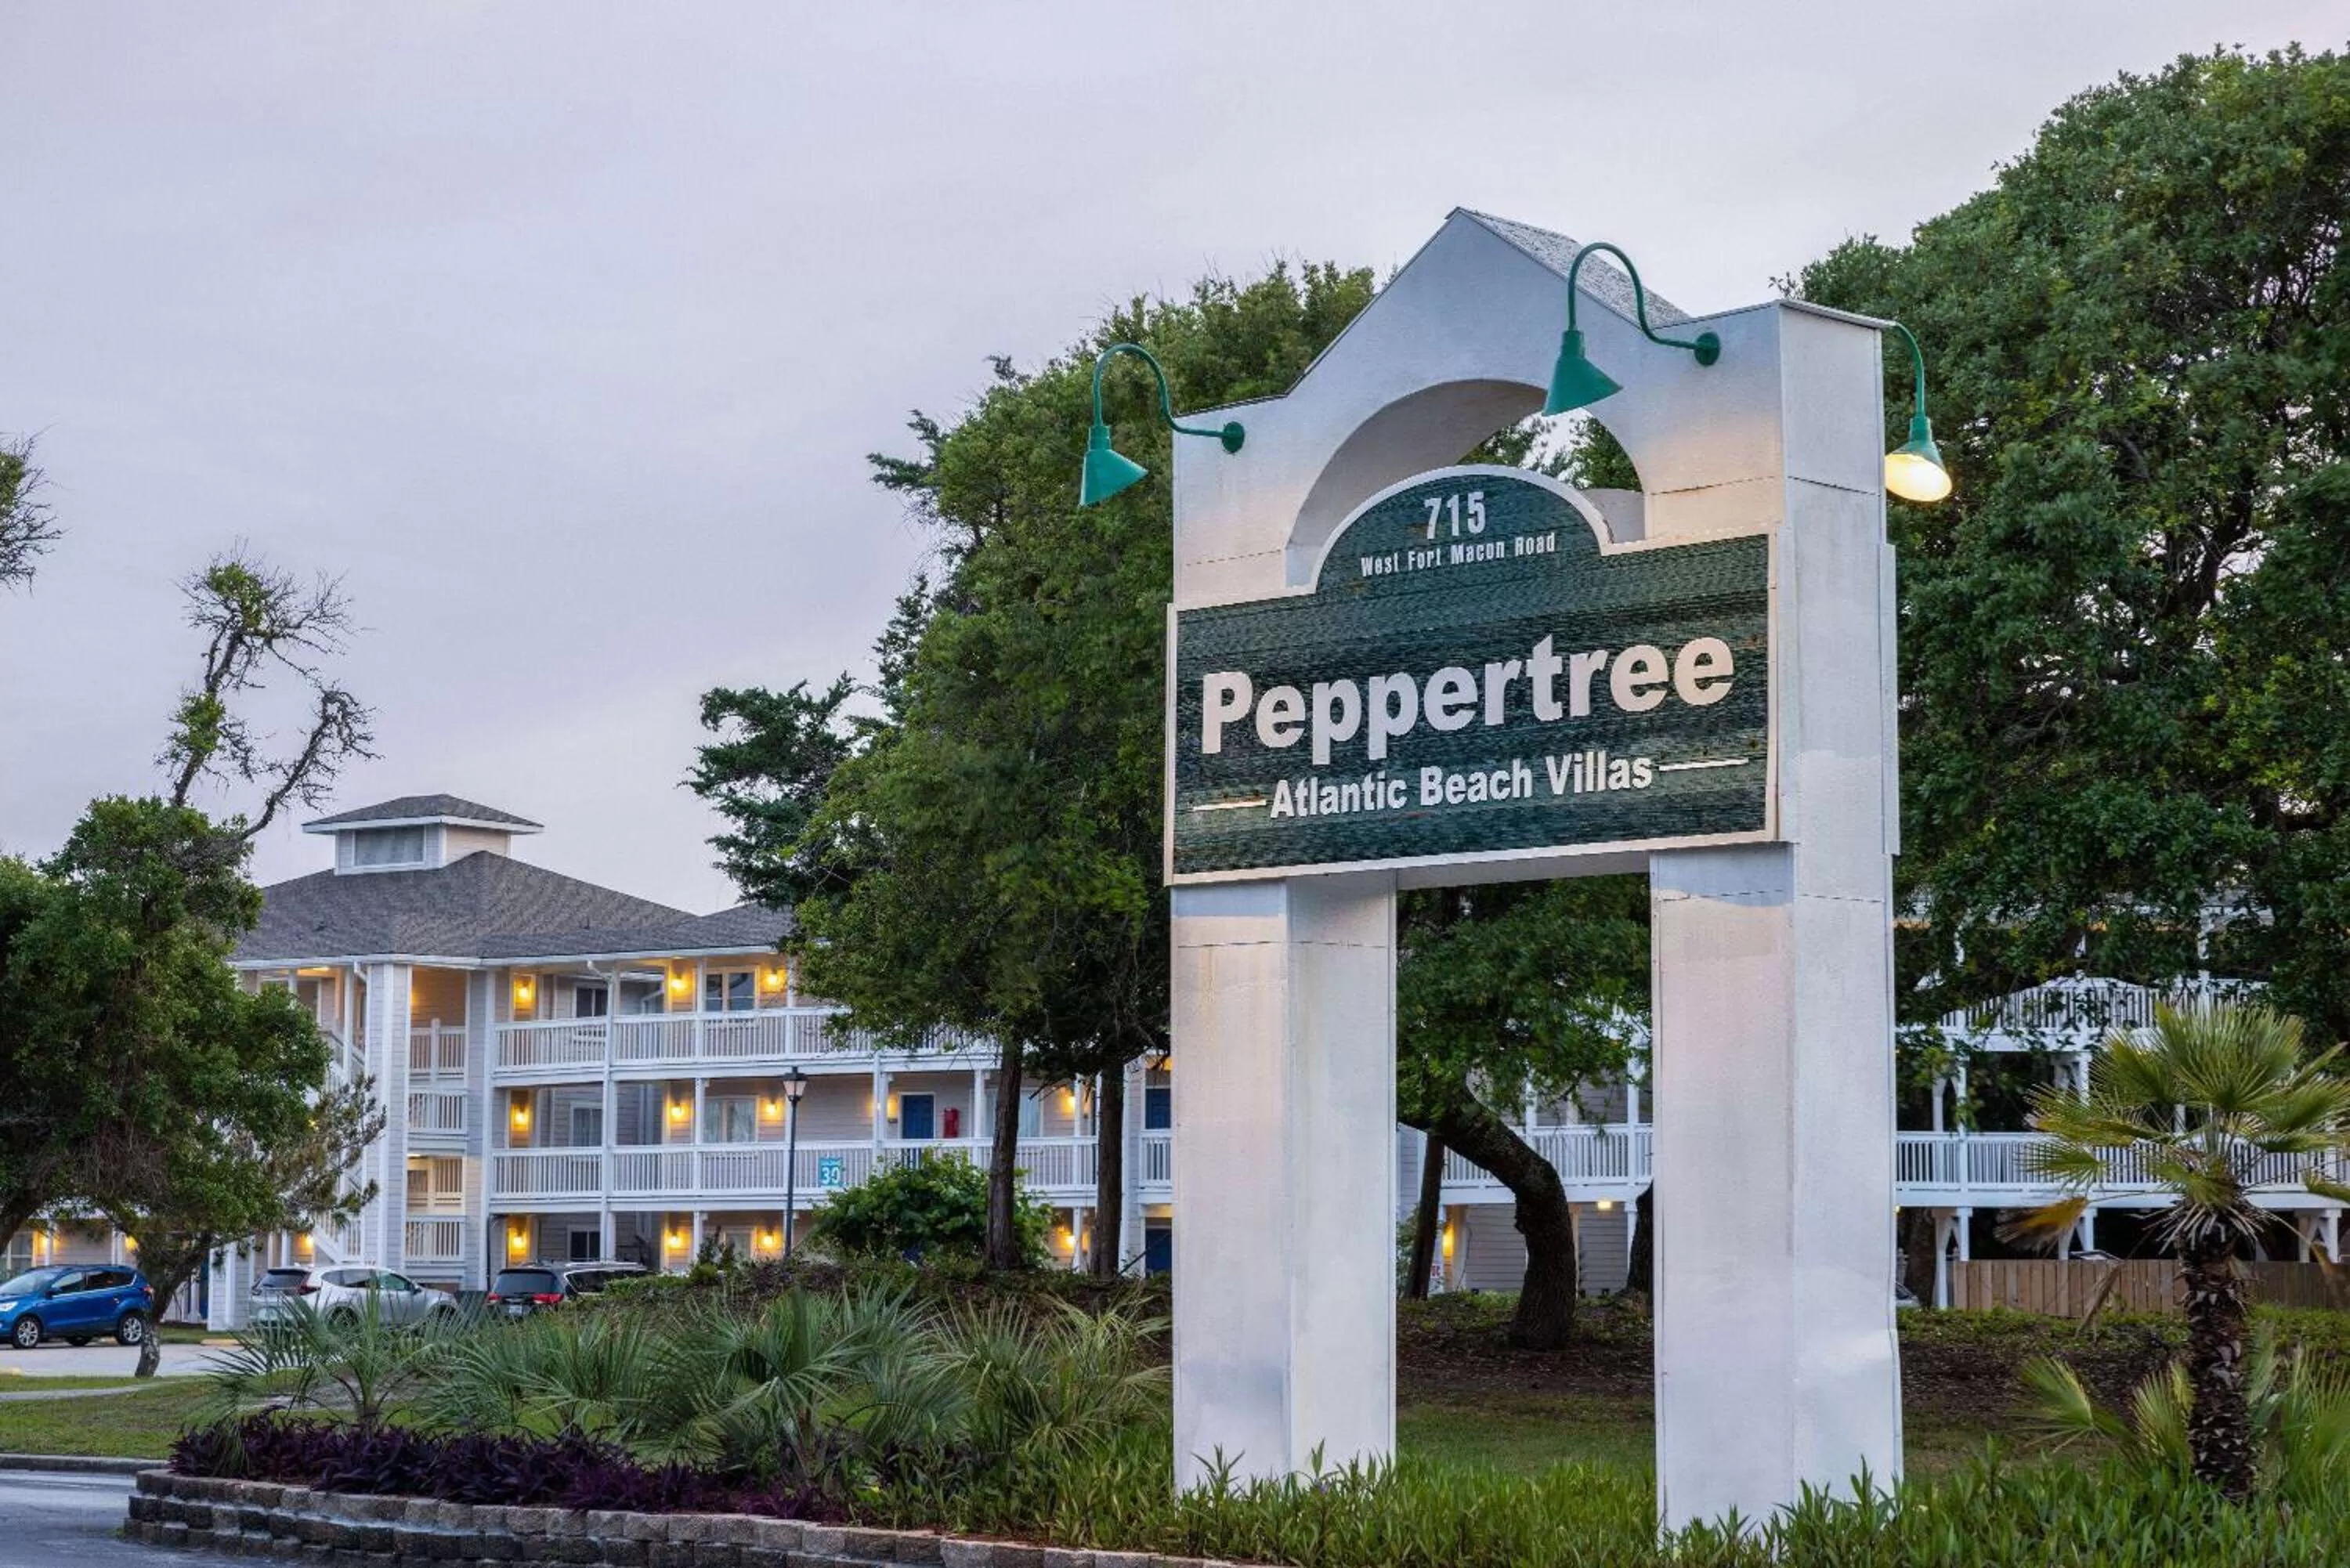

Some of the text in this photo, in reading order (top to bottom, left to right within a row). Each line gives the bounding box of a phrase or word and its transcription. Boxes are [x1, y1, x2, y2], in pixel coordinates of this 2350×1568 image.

[1423, 491, 1486, 540] 715
[1361, 532, 1556, 577] West Fort Macon Road
[1201, 634, 1734, 766] Peppertree
[1269, 750, 1653, 818] Atlantic Beach Villas
